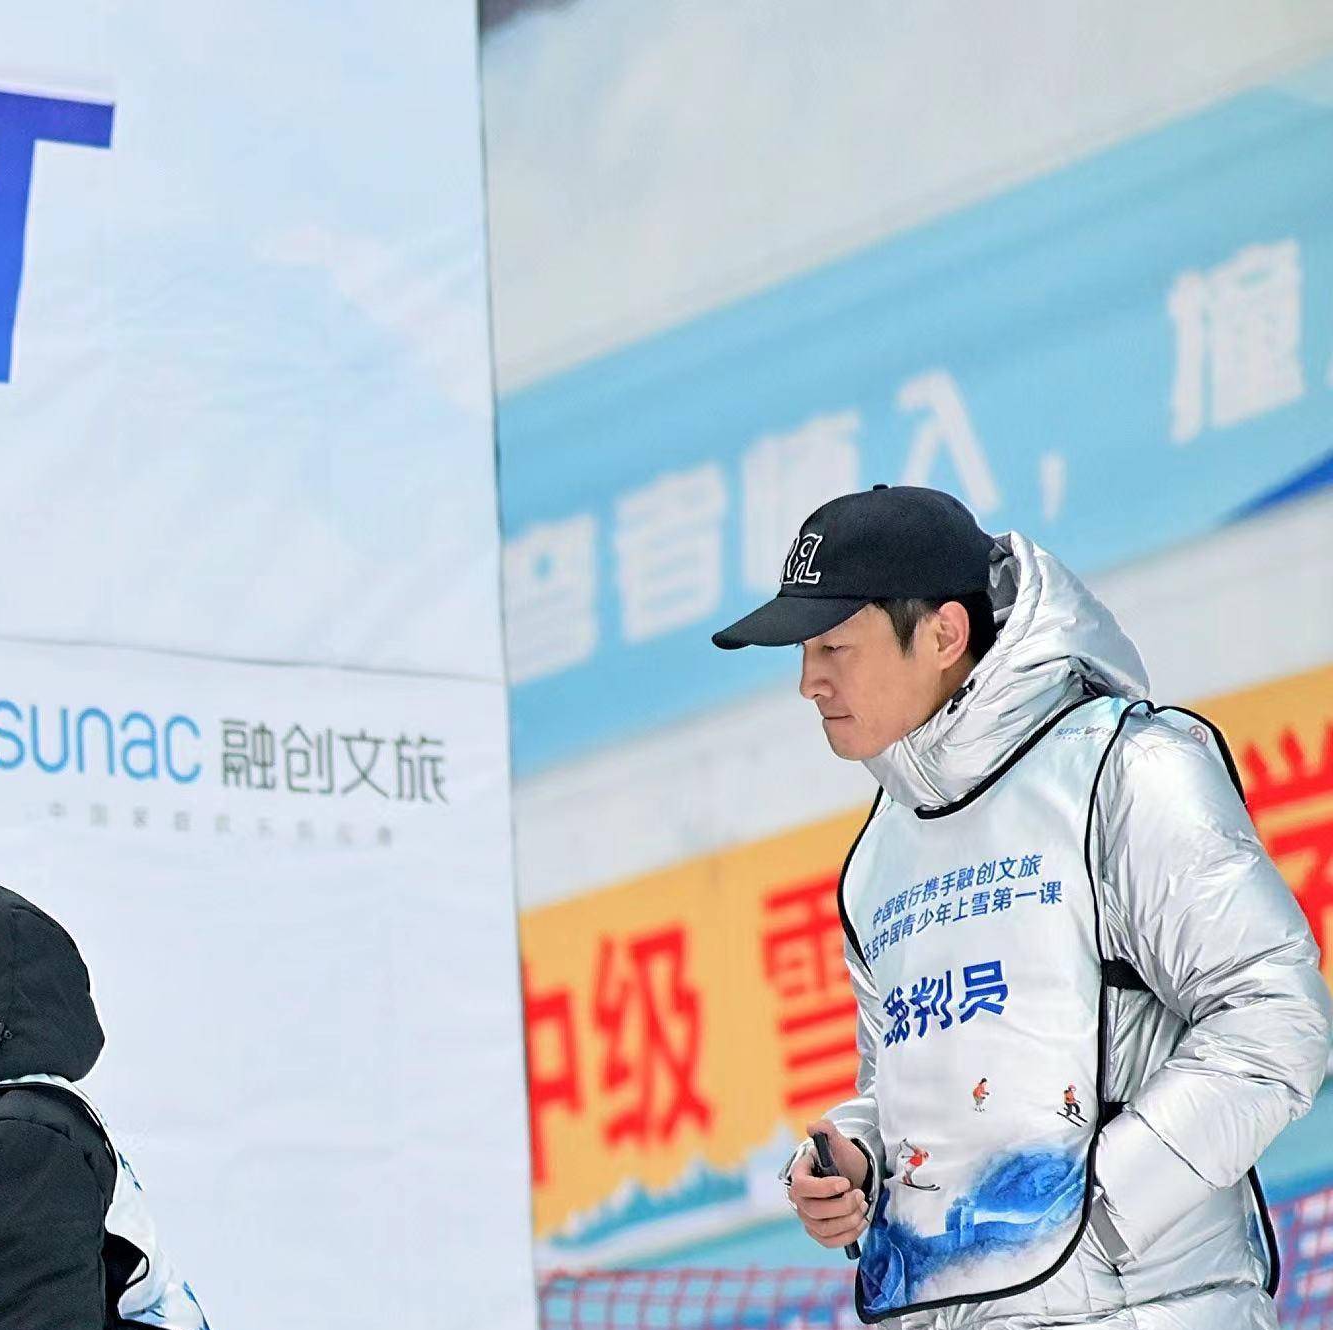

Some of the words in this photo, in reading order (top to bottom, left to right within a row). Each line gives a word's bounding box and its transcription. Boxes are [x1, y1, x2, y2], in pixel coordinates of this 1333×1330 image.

[220, 718, 451, 805] 融创文旅
[873, 854, 1043, 931] 中国银行携手融创文旅
[883, 960, 1009, 1049] 裁判员
